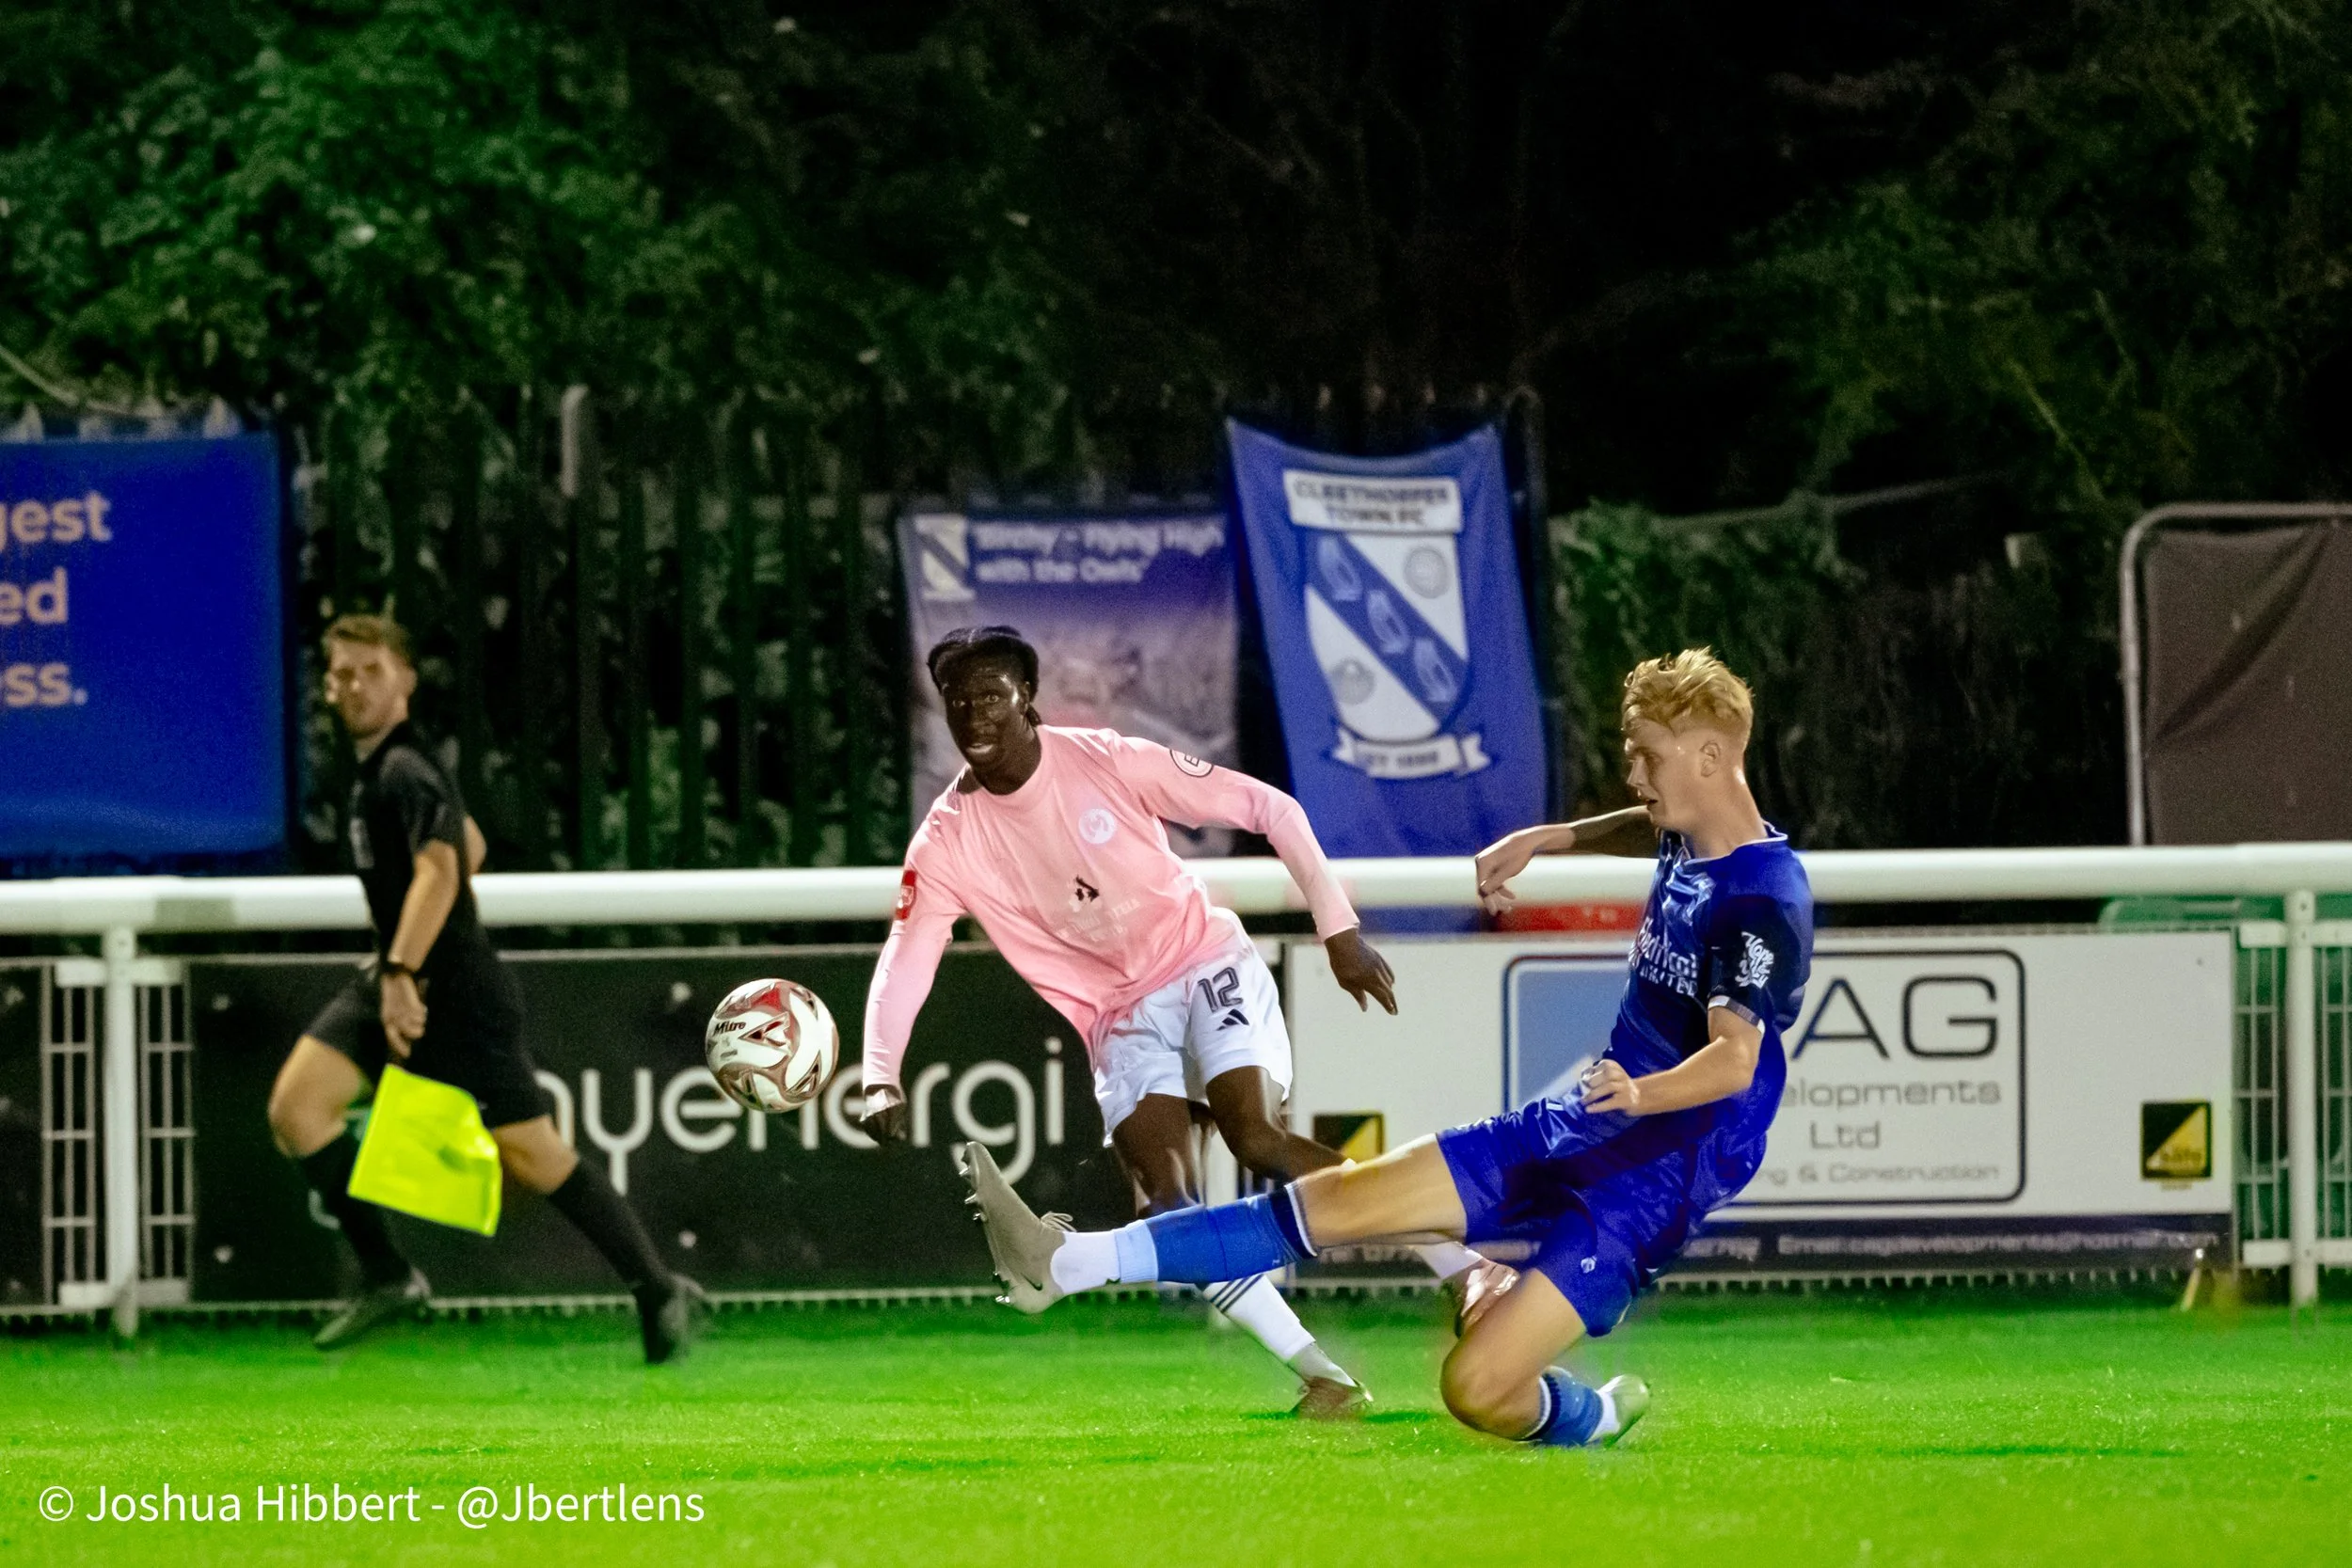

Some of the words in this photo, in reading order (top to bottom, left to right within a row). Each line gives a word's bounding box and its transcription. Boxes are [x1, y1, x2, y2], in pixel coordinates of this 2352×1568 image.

[0, 490, 112, 555] est
[1326, 505, 1393, 524] TOWN
[976, 558, 1030, 582] with
[1035, 558, 1076, 582] the
[1197, 967, 1244, 1013] 12
[713, 1022, 747, 1037] Mitre
[1810, 1120, 1880, 1150] Ltd
[1798, 1164, 1819, 1183] &
[1828, 1164, 2000, 1183] Construction
